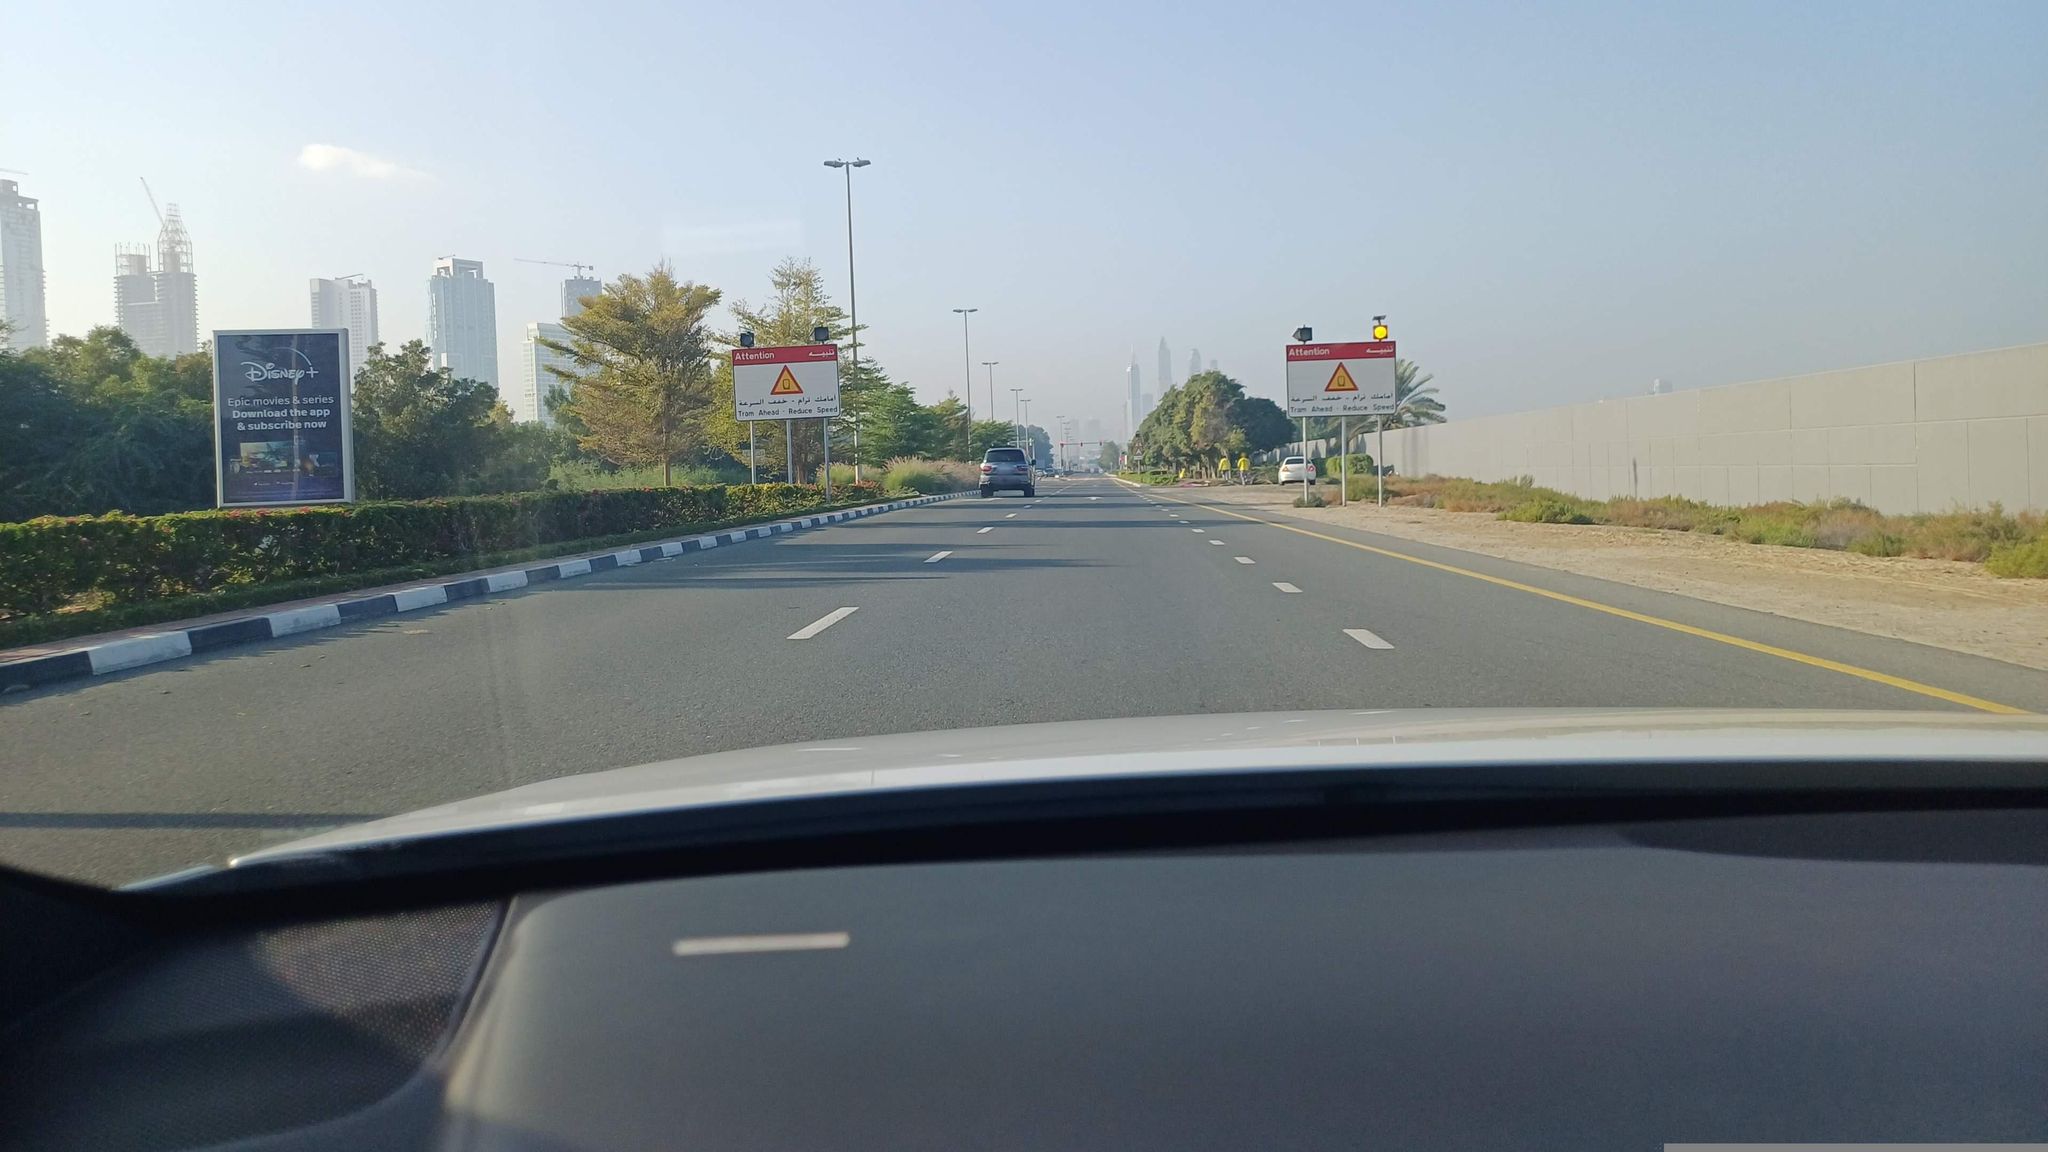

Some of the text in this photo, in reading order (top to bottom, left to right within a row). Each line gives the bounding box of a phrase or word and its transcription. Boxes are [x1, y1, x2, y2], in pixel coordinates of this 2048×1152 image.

[735, 350, 775, 360] Attention
[1288, 347, 1330, 356] Attention
[240, 361, 319, 385] Disney+
[227, 394, 335, 408] Epic movies & series
[788, 407, 813, 415] Reduce
[816, 406, 838, 414] Speed
[1372, 403, 1395, 411] Speed
[232, 408, 331, 419] Download the app
[236, 420, 327, 431] & subscribe now
